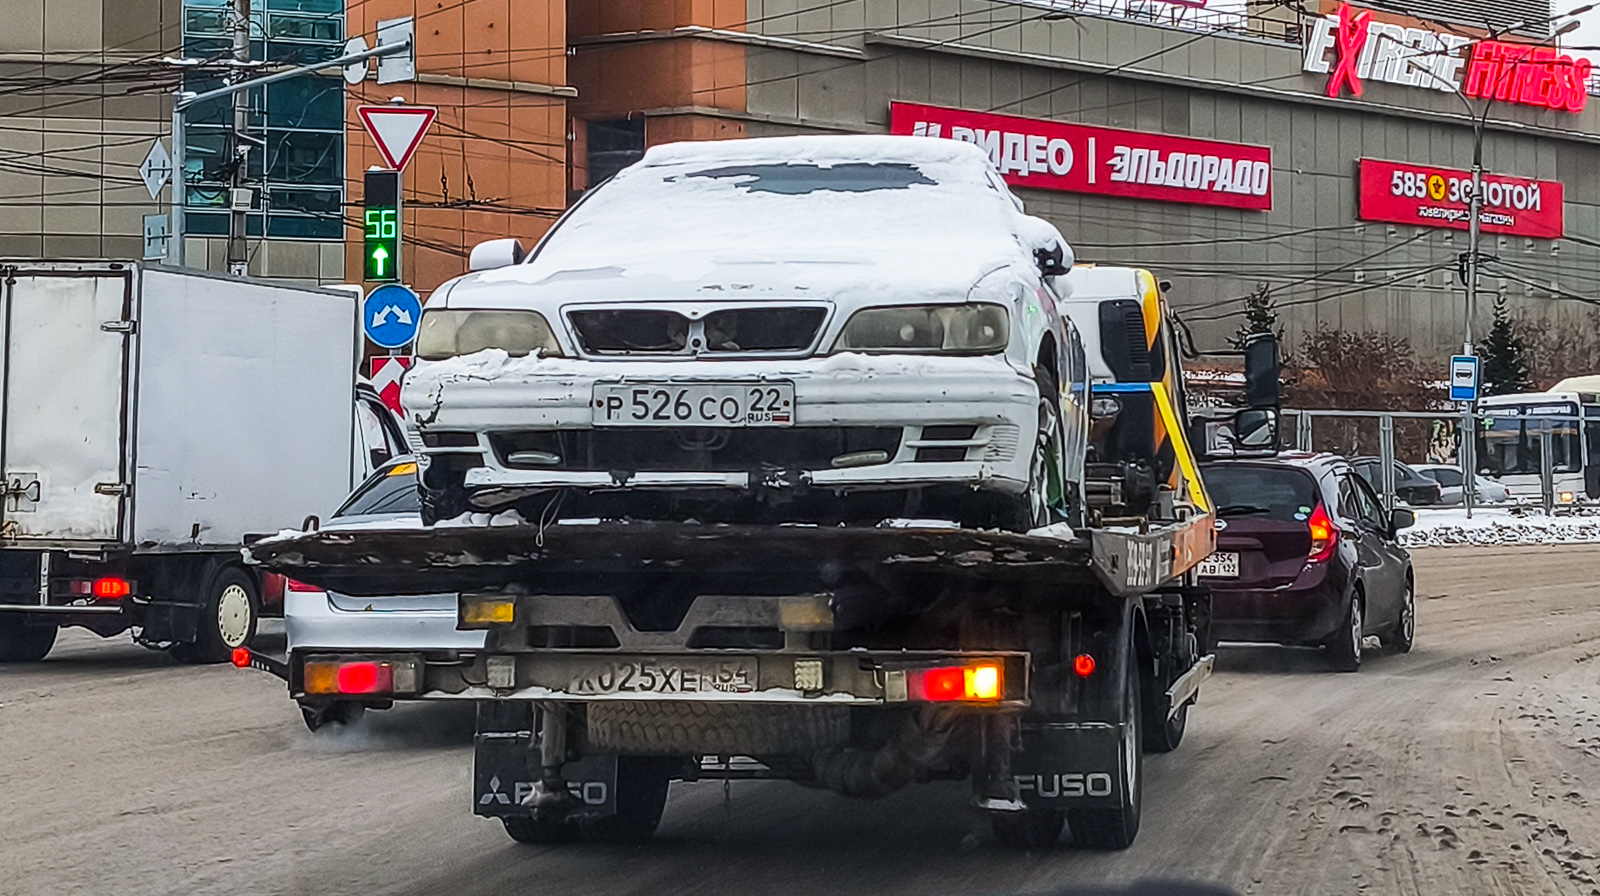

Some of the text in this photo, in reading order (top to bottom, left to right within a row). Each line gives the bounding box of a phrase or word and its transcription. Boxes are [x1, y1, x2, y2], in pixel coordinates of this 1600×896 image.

[1303, 2, 1592, 114] EXTREME FITNESS
[1106, 145, 1270, 196] ЭЛЬДОРАДО
[1391, 170, 1427, 199] 585
[365, 209, 396, 238] 56
[749, 388, 781, 412] 22
[747, 412, 772, 423] RUS
[514, 781, 608, 805] FO
[1013, 773, 1112, 797] FUSO
